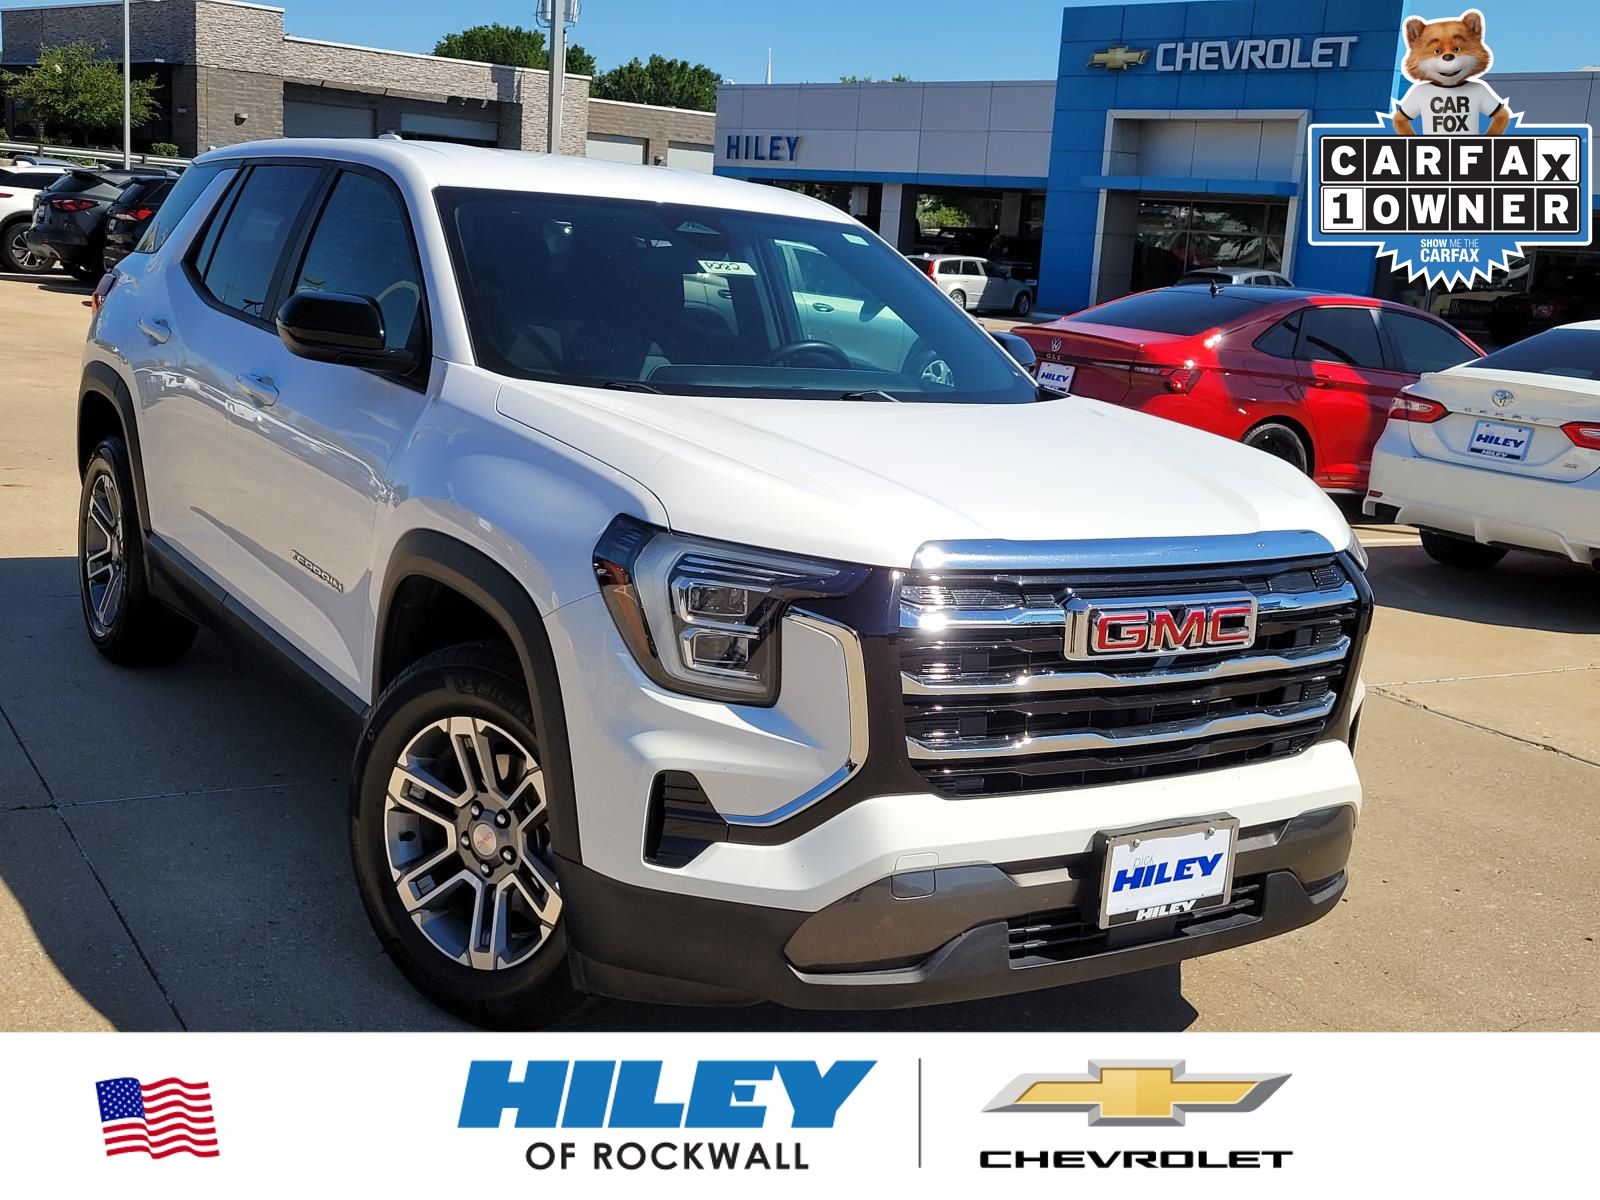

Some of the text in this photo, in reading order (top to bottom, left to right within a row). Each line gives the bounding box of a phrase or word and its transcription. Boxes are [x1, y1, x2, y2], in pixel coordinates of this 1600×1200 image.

[1156, 36, 1358, 72] CHEVROLET
[726, 135, 800, 161] HILEY
[1041, 372, 1069, 382] HILEY
[1476, 433, 1525, 448] HILEY
[1481, 449, 1508, 459] HILEY
[1097, 606, 1254, 651] GMC
[1112, 852, 1224, 893] HILEY
[1135, 899, 1197, 921] HILEY
